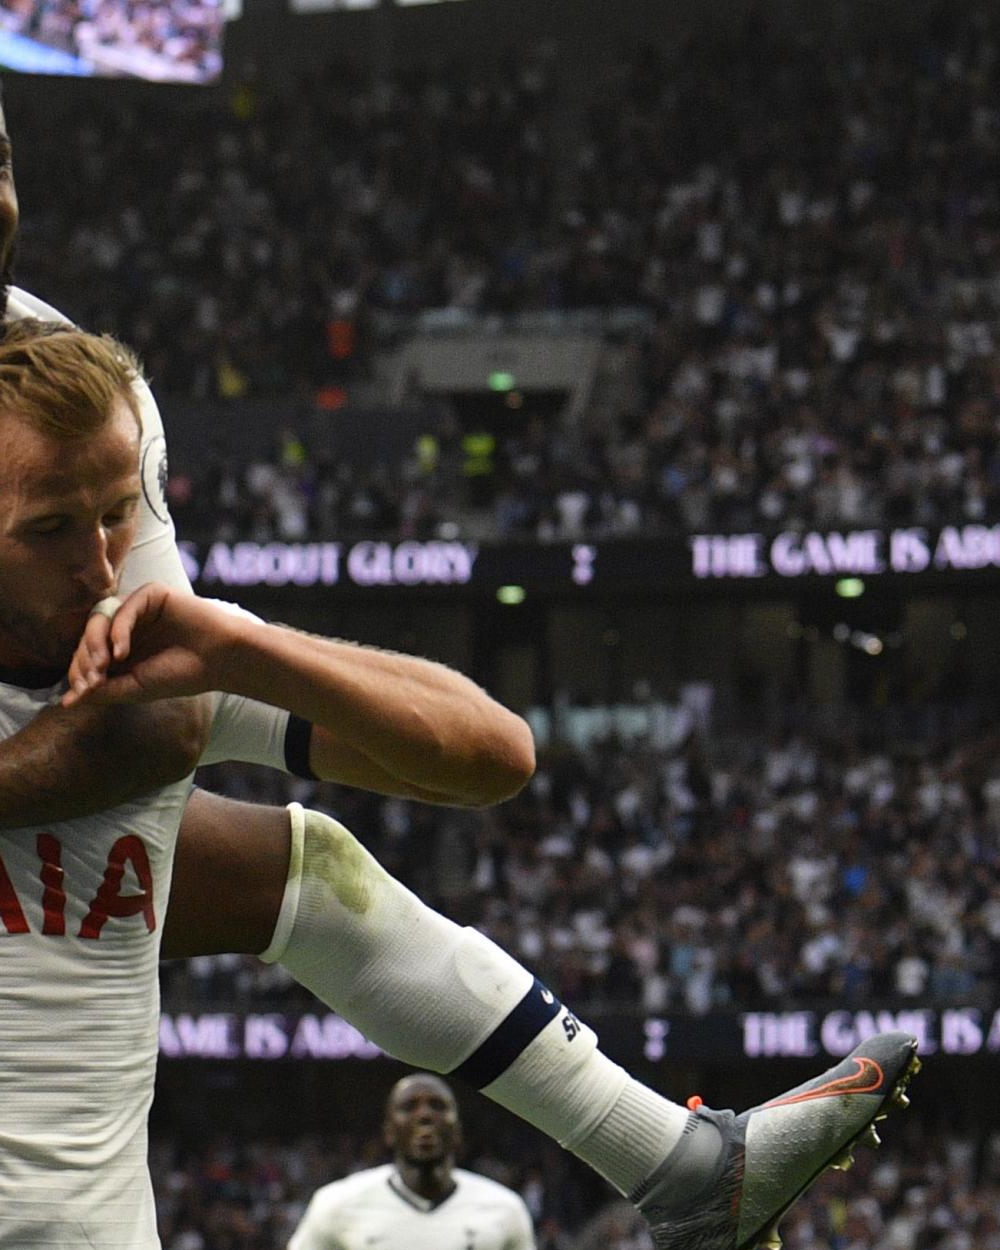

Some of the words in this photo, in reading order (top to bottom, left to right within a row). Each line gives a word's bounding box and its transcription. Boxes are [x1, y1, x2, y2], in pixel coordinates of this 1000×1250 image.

[203, 541, 342, 586] ABOUT
[347, 541, 478, 586] GLORY
[692, 533, 766, 579] THE
[771, 530, 884, 576] GAME
[890, 527, 930, 573] IS
[245, 1013, 287, 1060] IS
[291, 1013, 383, 1060] AB
[743, 1010, 816, 1057] THE
[942, 1008, 983, 1055] IS
